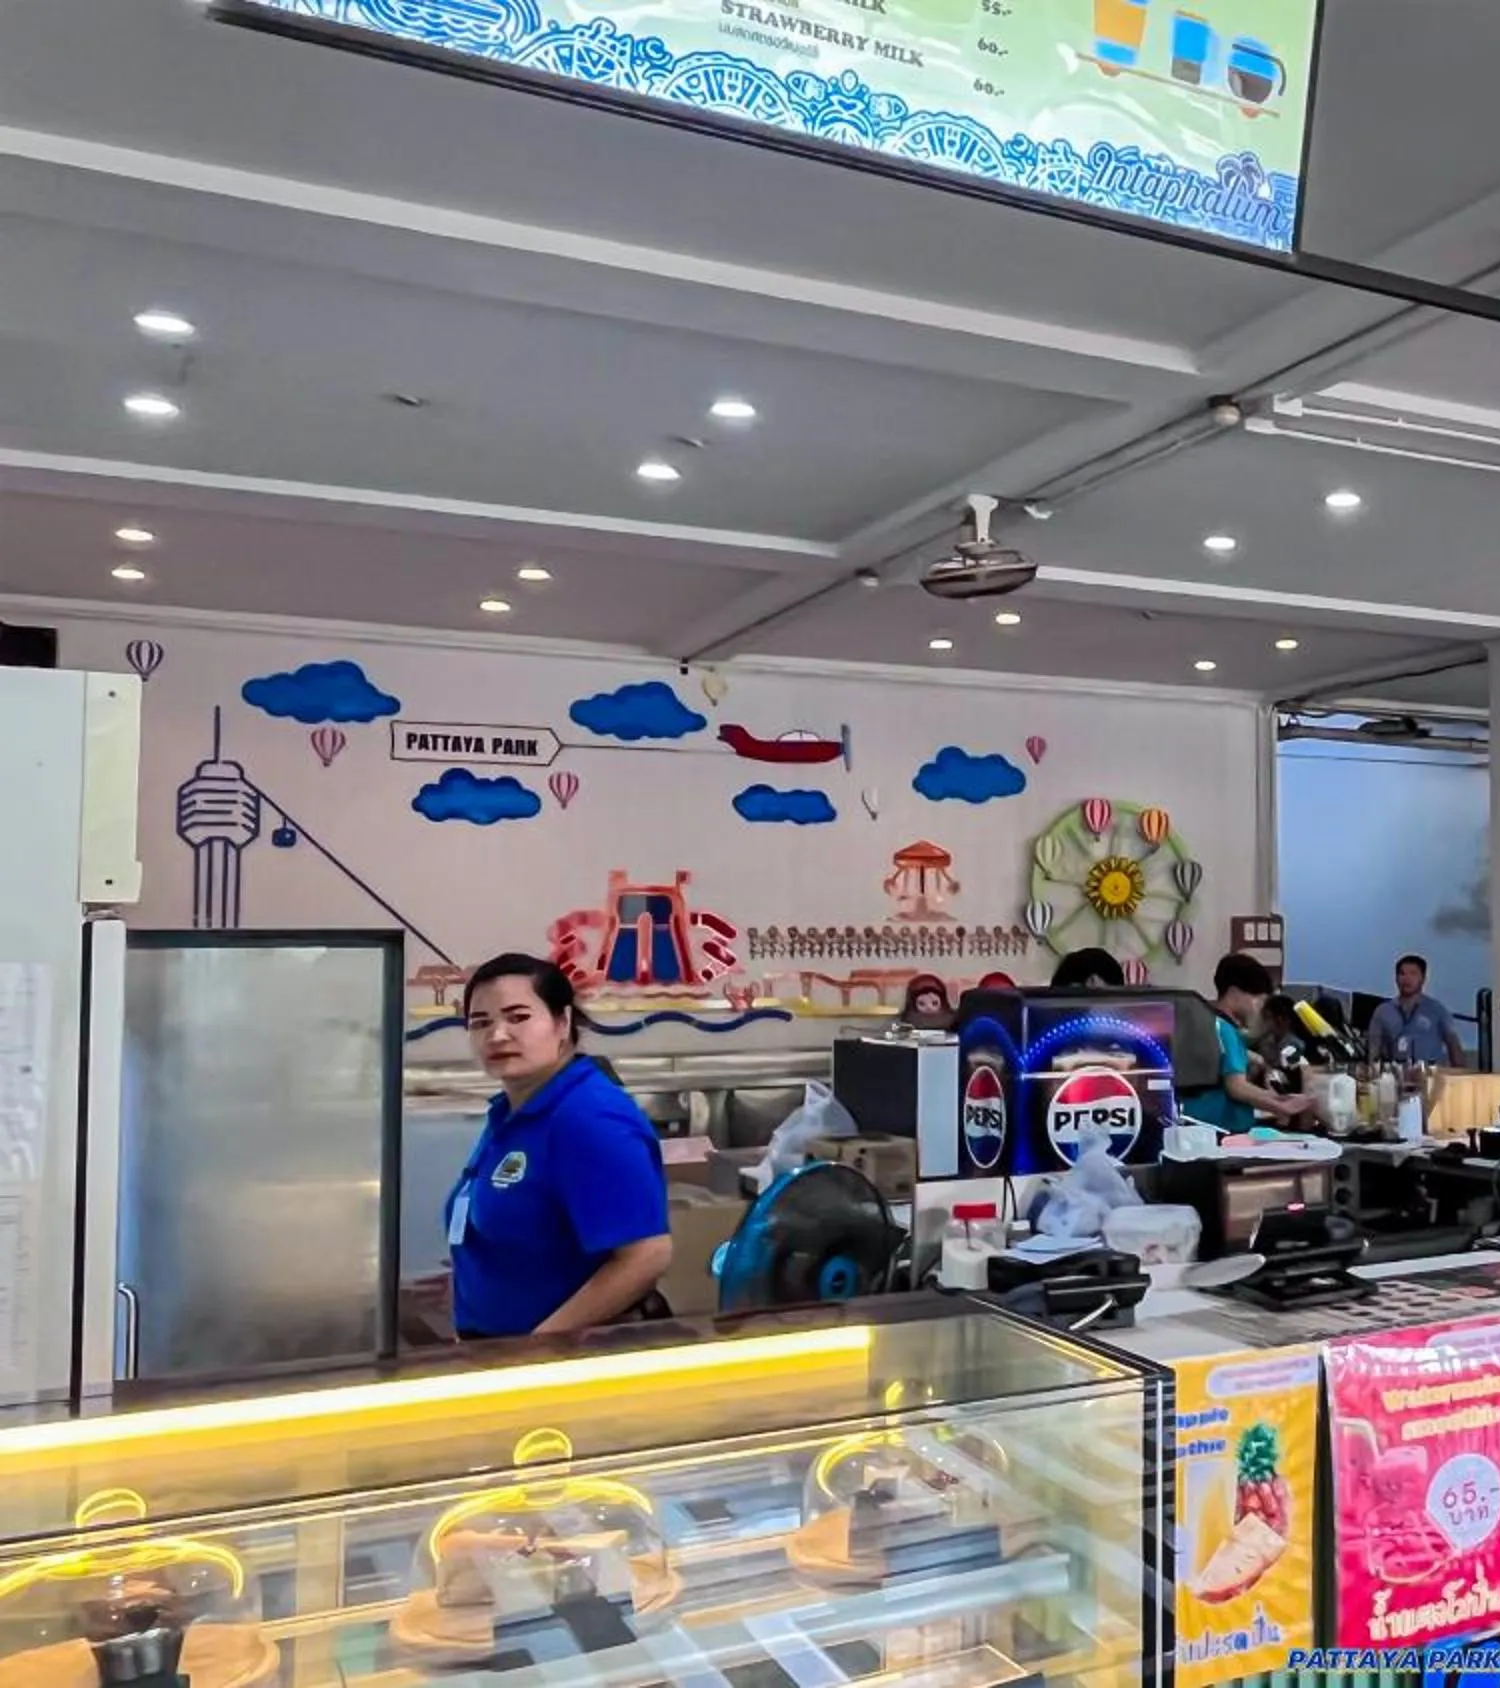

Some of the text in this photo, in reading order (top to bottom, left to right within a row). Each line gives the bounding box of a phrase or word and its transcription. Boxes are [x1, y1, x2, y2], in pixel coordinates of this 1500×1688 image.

[720, 0, 869, 51] STRAWBERRY
[874, 40, 924, 67] MILK
[1089, 142, 1283, 231] Intaphalum
[406, 732, 538, 757] PATTAYA PARK
